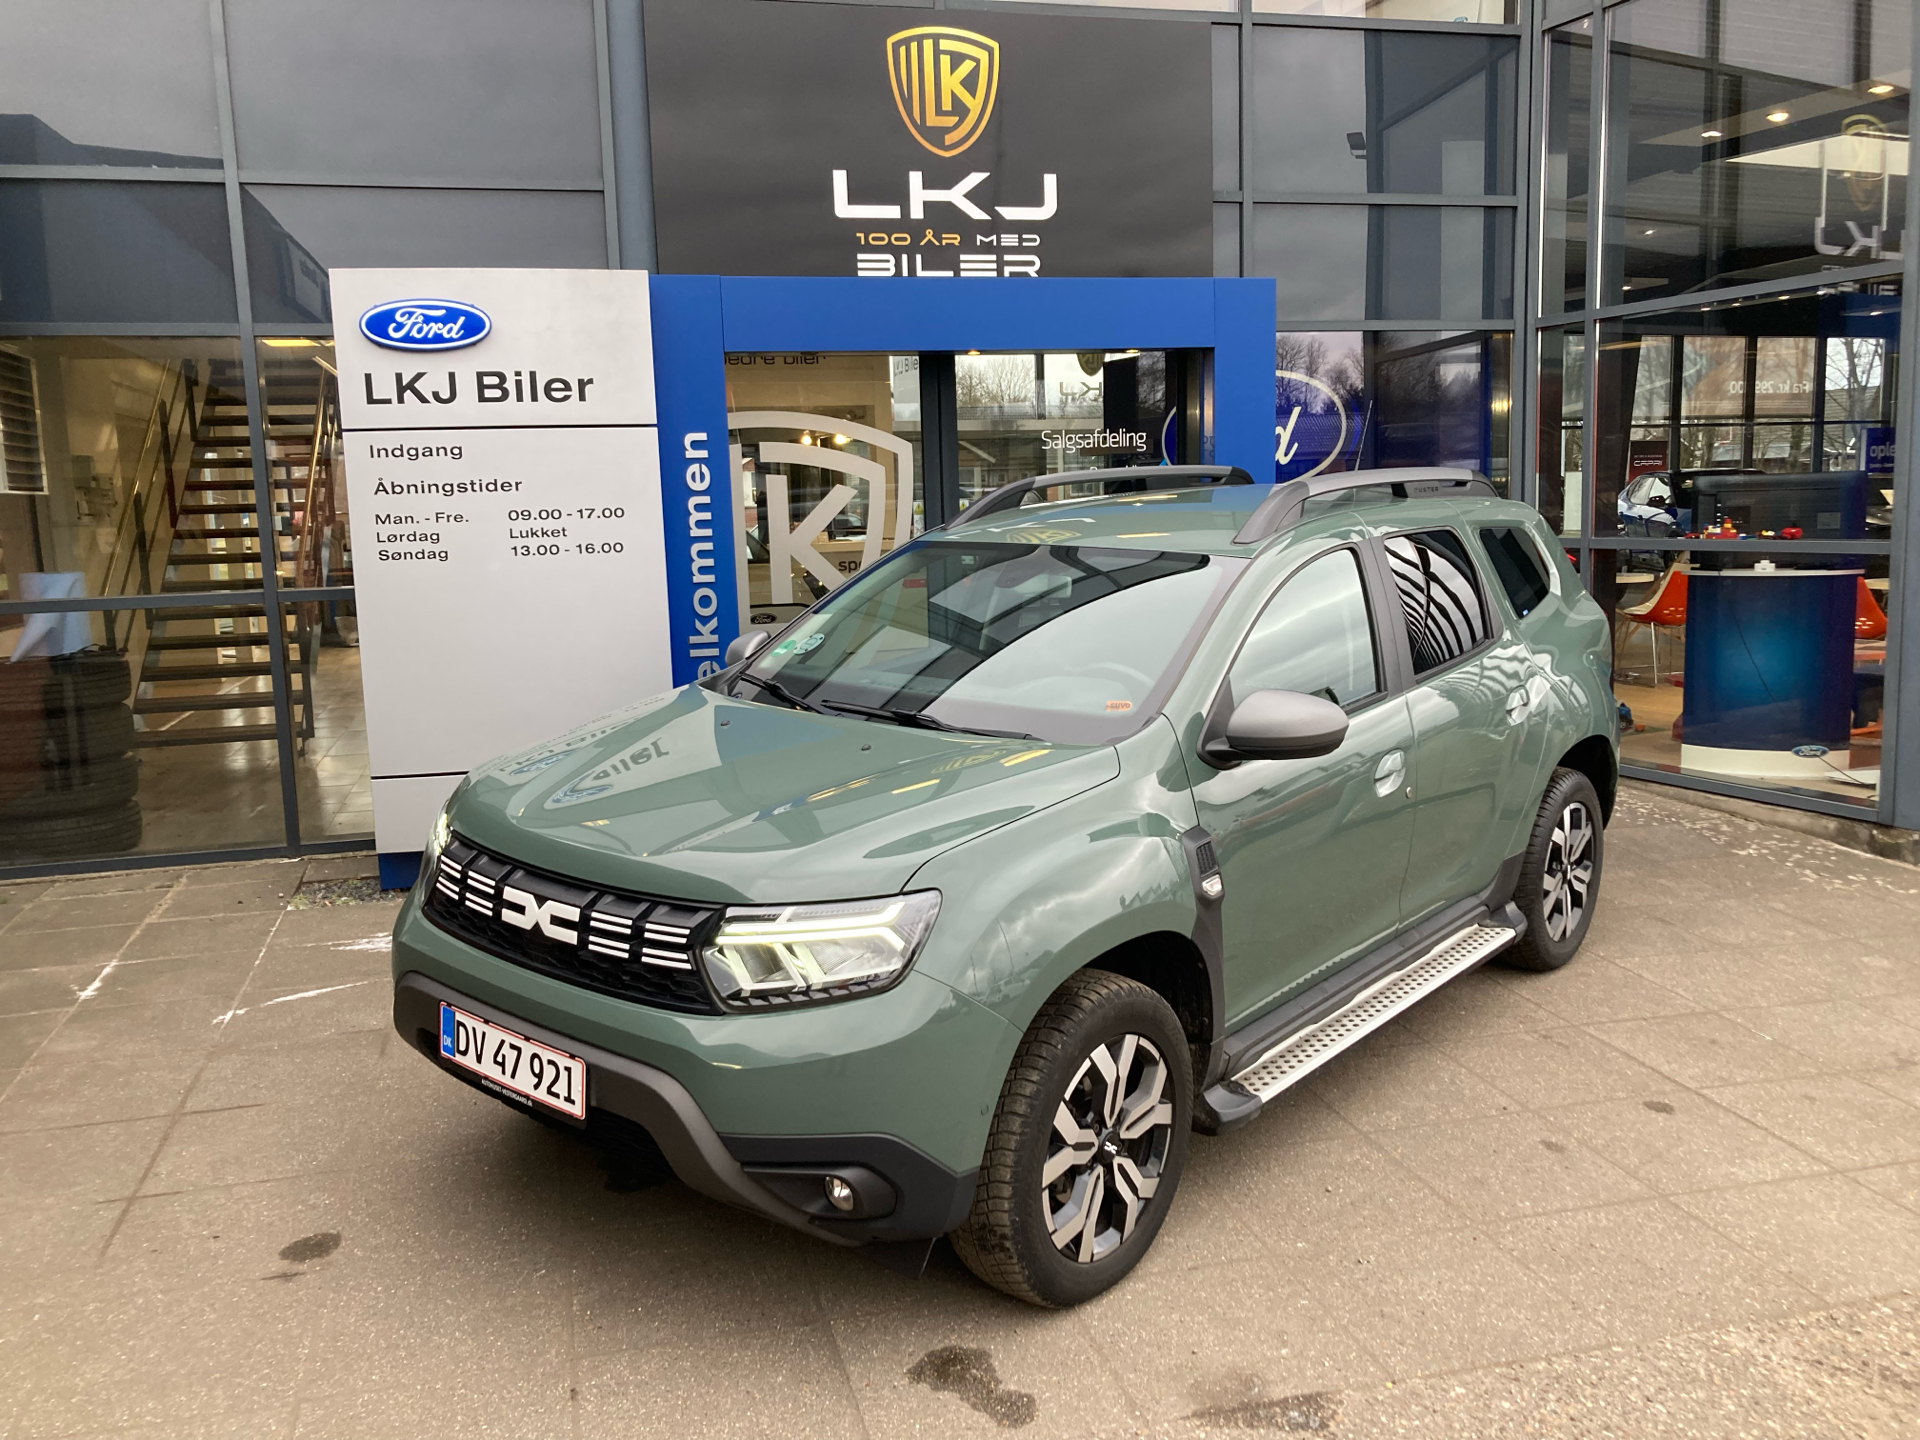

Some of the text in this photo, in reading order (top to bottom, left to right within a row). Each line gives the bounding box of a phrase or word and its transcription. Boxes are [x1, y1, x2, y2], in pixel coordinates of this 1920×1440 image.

[832, 169, 1058, 220] LKJ
[856, 228, 1041, 247] 100 ÅR MED
[857, 253, 1041, 278] BILER
[387, 307, 466, 341] Ford
[363, 370, 595, 405] LKJ Biler
[1041, 429, 1148, 454] Salgsafdeling
[1869, 441, 1896, 460] ople
[369, 444, 463, 461] Indgang
[374, 477, 523, 497] Åbningstider
[375, 513, 420, 526] Man.
[435, 512, 469, 524] Fre.
[508, 508, 562, 521] 09.00
[576, 507, 625, 519] 17.00
[376, 526, 568, 544] Lørdag Lukket
[378, 548, 449, 562] Søndag
[510, 544, 560, 556] 13.00
[575, 542, 624, 554] 16.00
[684, 431, 722, 680] elkommen
[838, 560, 862, 573] sp
[443, 1034, 453, 1048] DK
[456, 1020, 576, 1106] DV 47 921
